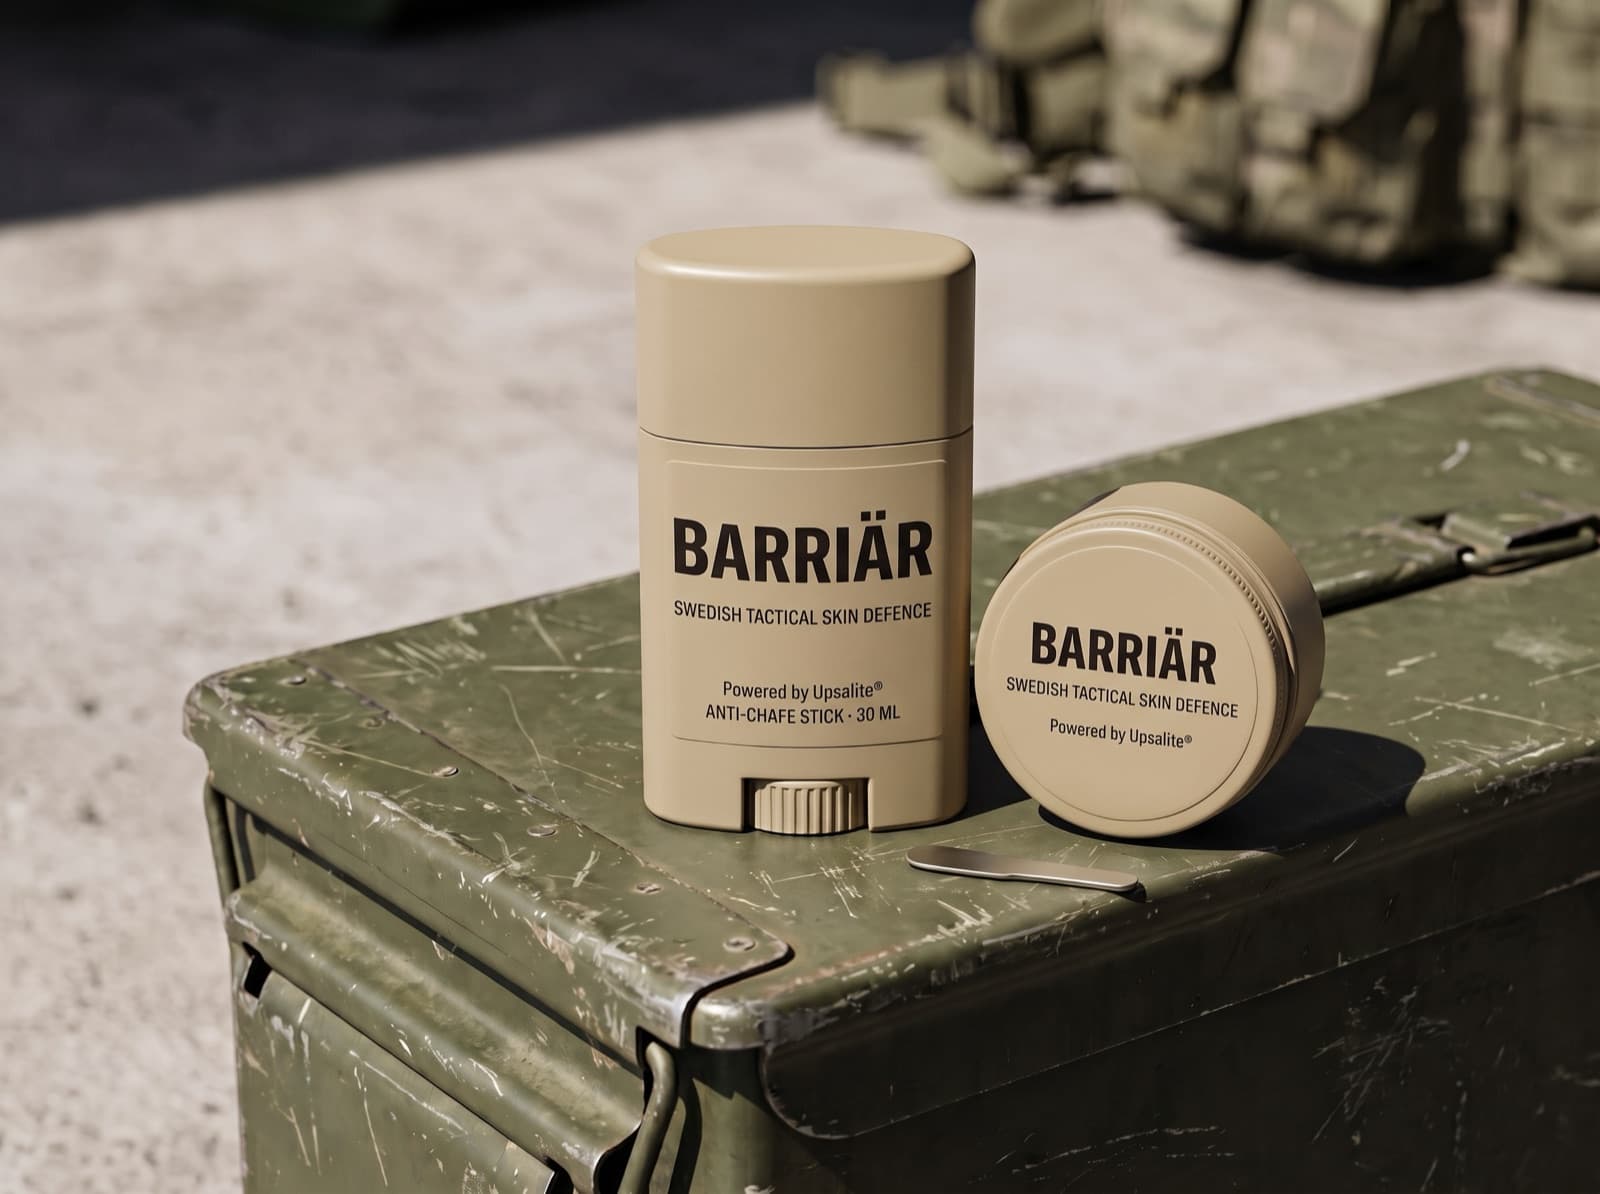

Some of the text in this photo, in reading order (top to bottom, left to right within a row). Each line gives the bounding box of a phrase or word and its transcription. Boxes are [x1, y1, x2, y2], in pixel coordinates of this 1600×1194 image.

[674, 510, 932, 583] BARRIÄR
[675, 600, 931, 625] SWEDISH TACTICAL SKIN DEFENCE
[1032, 622, 1216, 685] BARRIÄR
[724, 681, 786, 699] Powered
[792, 684, 808, 703] by
[1007, 677, 1238, 718] SWEDISH TACTICAL SKIN DEFENCE
[706, 704, 795, 724] ANTI-CHAFE
[801, 709, 844, 724] STICK
[857, 707, 874, 722] 30
[880, 705, 900, 720] ML
[1051, 719, 1106, 739] Powered
[1111, 726, 1126, 744] by
